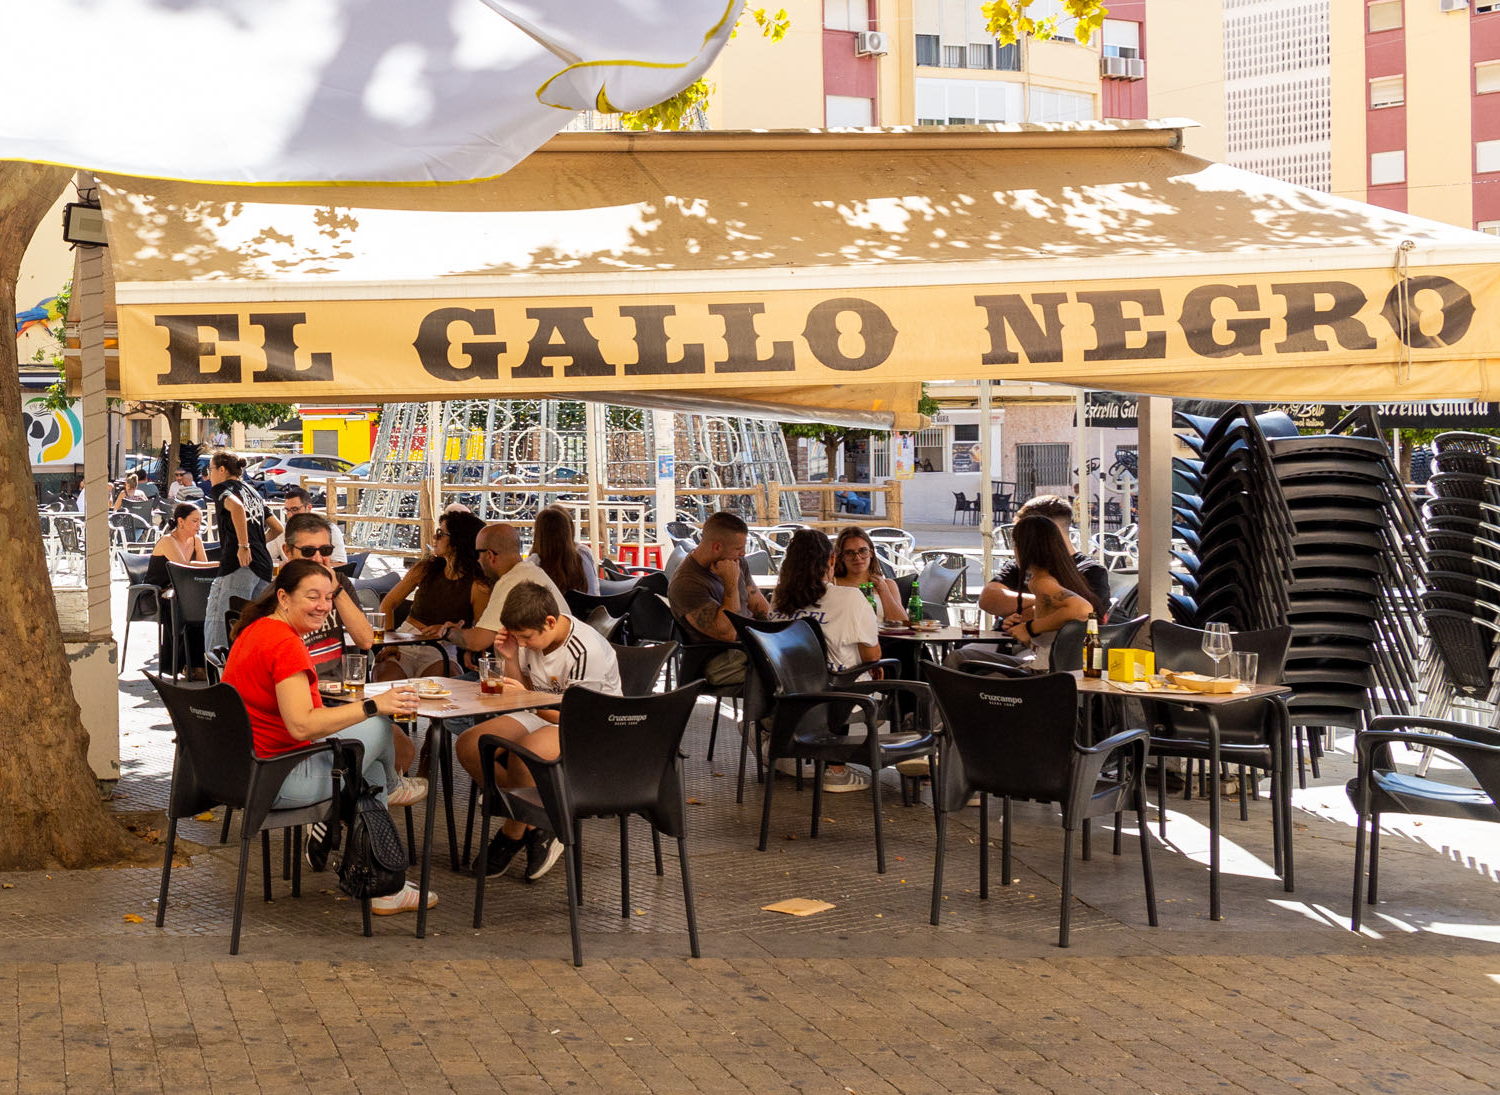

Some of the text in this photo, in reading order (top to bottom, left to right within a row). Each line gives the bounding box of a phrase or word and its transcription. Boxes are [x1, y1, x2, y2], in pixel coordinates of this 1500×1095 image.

[155, 275, 1476, 385] EL GALLO NEGRO
[1084, 402, 1119, 419] Estrella
[1377, 402, 1428, 417] strella
[980, 692, 1023, 704] Cruzcampo
[608, 714, 647, 722] Cruzcampo
